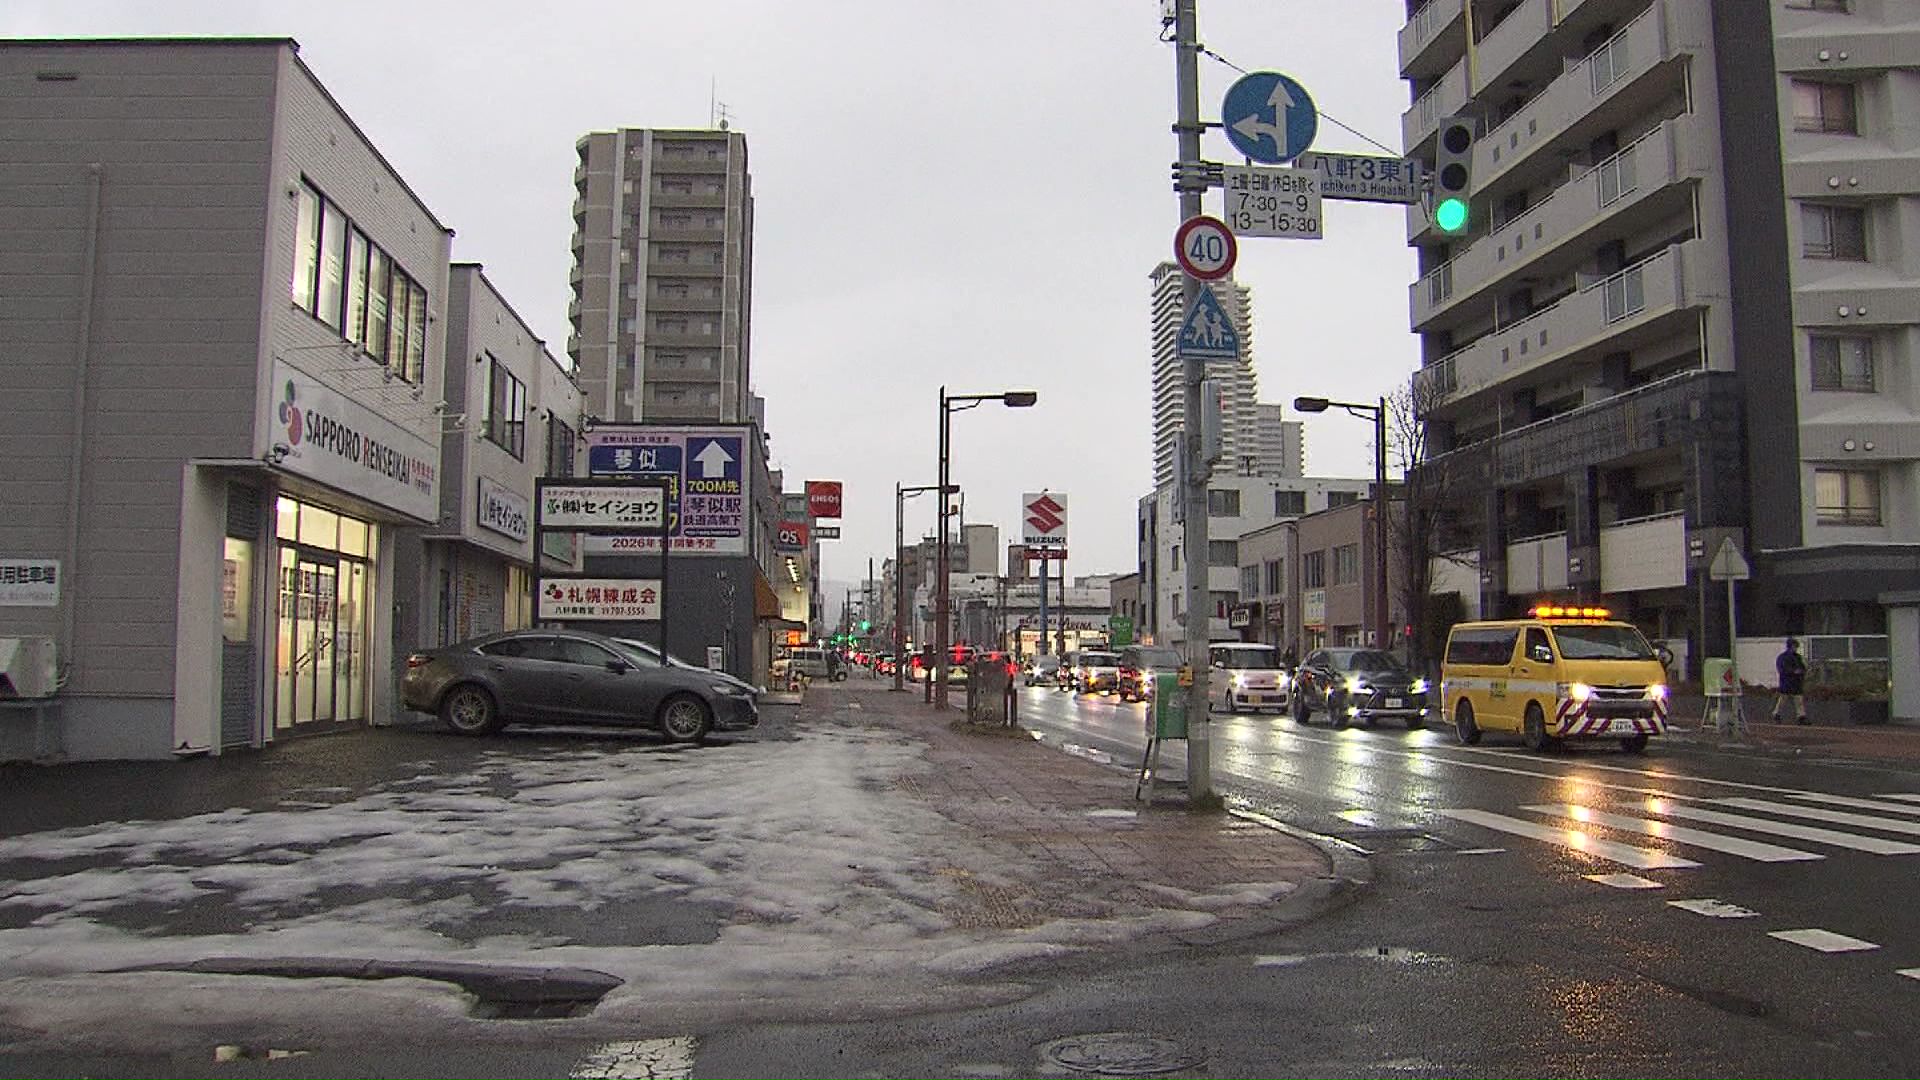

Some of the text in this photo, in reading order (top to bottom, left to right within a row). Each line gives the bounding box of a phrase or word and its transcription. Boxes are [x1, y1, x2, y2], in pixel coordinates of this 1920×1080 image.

[1190, 233, 1223, 262] 40
[305, 409, 410, 485] SAPPORO RENSEIKAI
[614, 448, 657, 470] 琴似
[687, 480, 739, 493] 700M先
[811, 495, 839, 503] ENEOS
[684, 515, 741, 525] 鉄道高架下
[1024, 536, 1066, 544] SUZUKI
[567, 587, 656, 603] 札幌練成会
